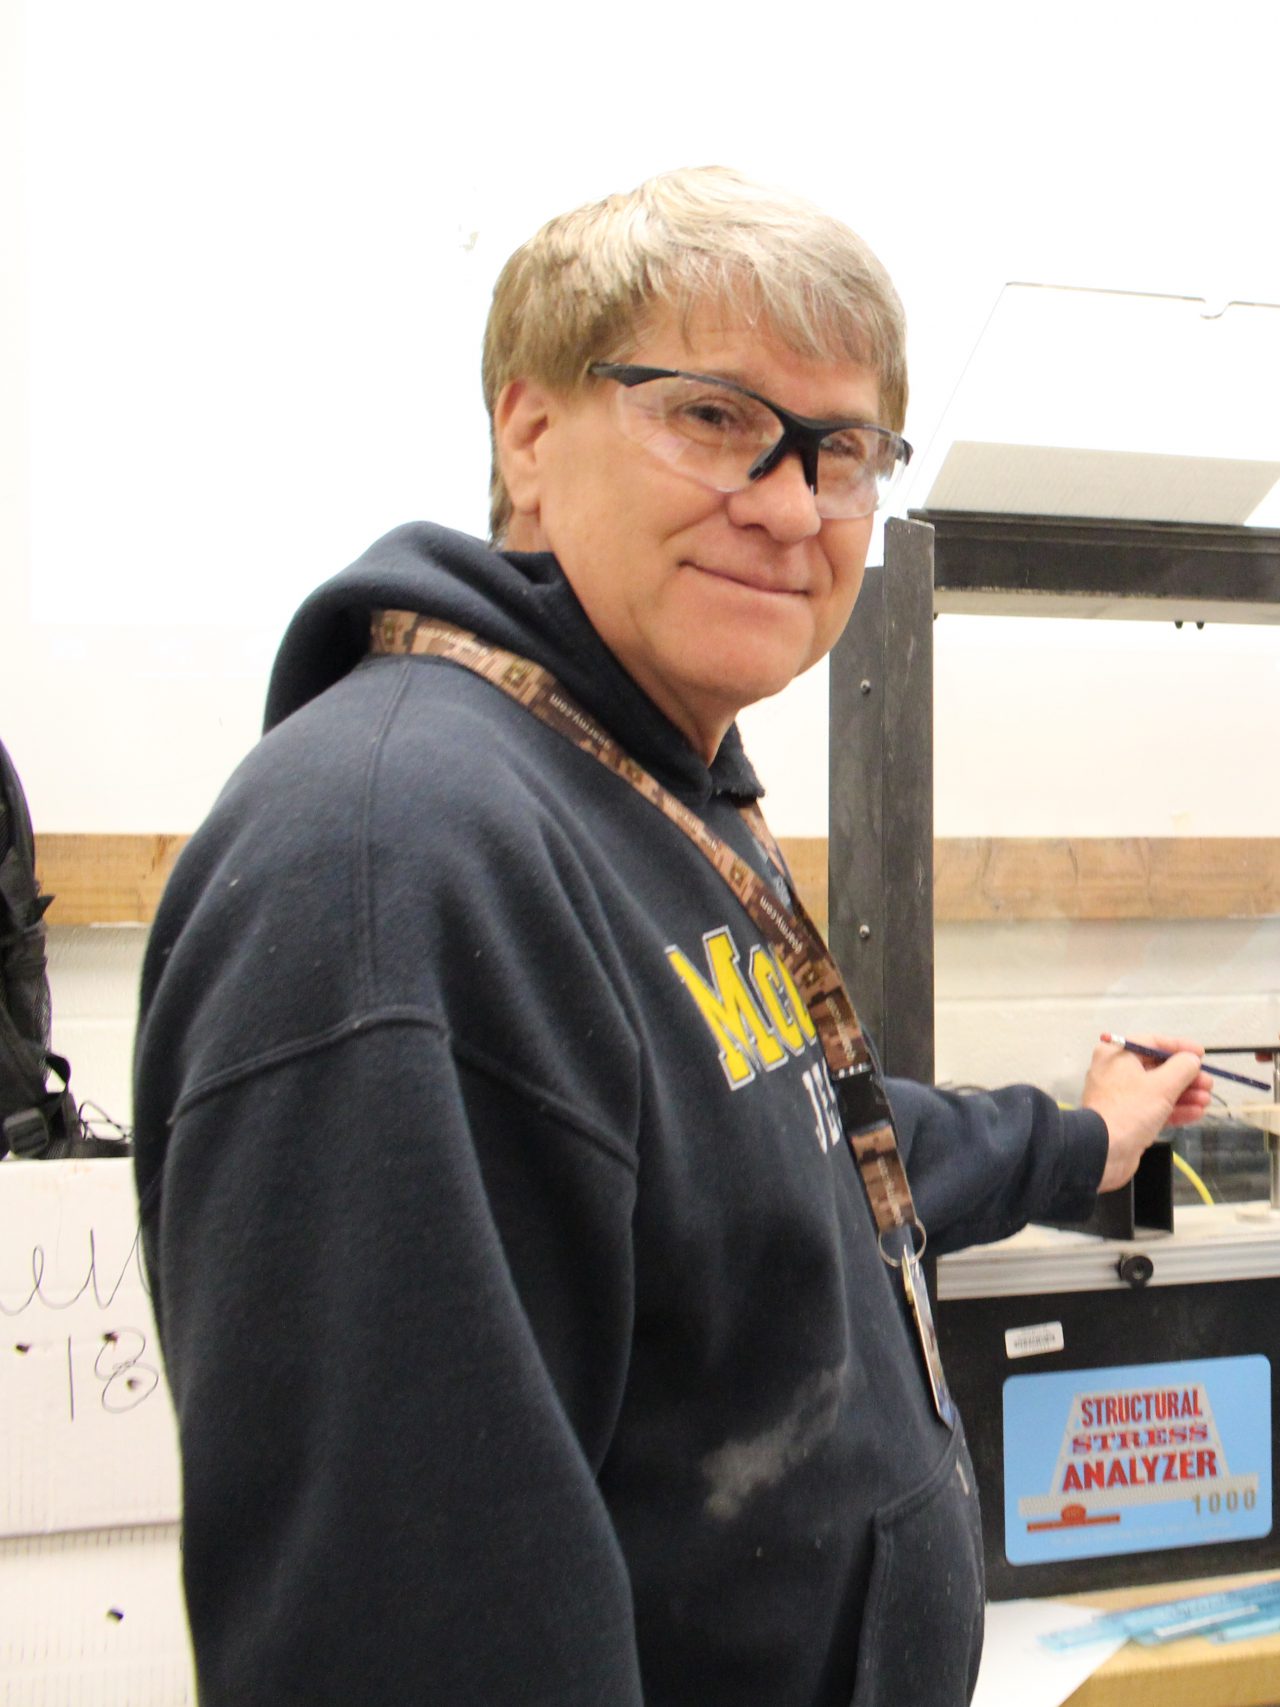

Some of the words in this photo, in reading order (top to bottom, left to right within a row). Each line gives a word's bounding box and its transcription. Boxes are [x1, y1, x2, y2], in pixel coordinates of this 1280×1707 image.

[759, 895, 803, 955] goarmy.com
[1080, 1388, 1203, 1429] STRUCTURAL
[1071, 1423, 1208, 1455] STRESS
[1062, 1449, 1218, 1493] ANALYZER
[1192, 1489, 1257, 1515] 1000
